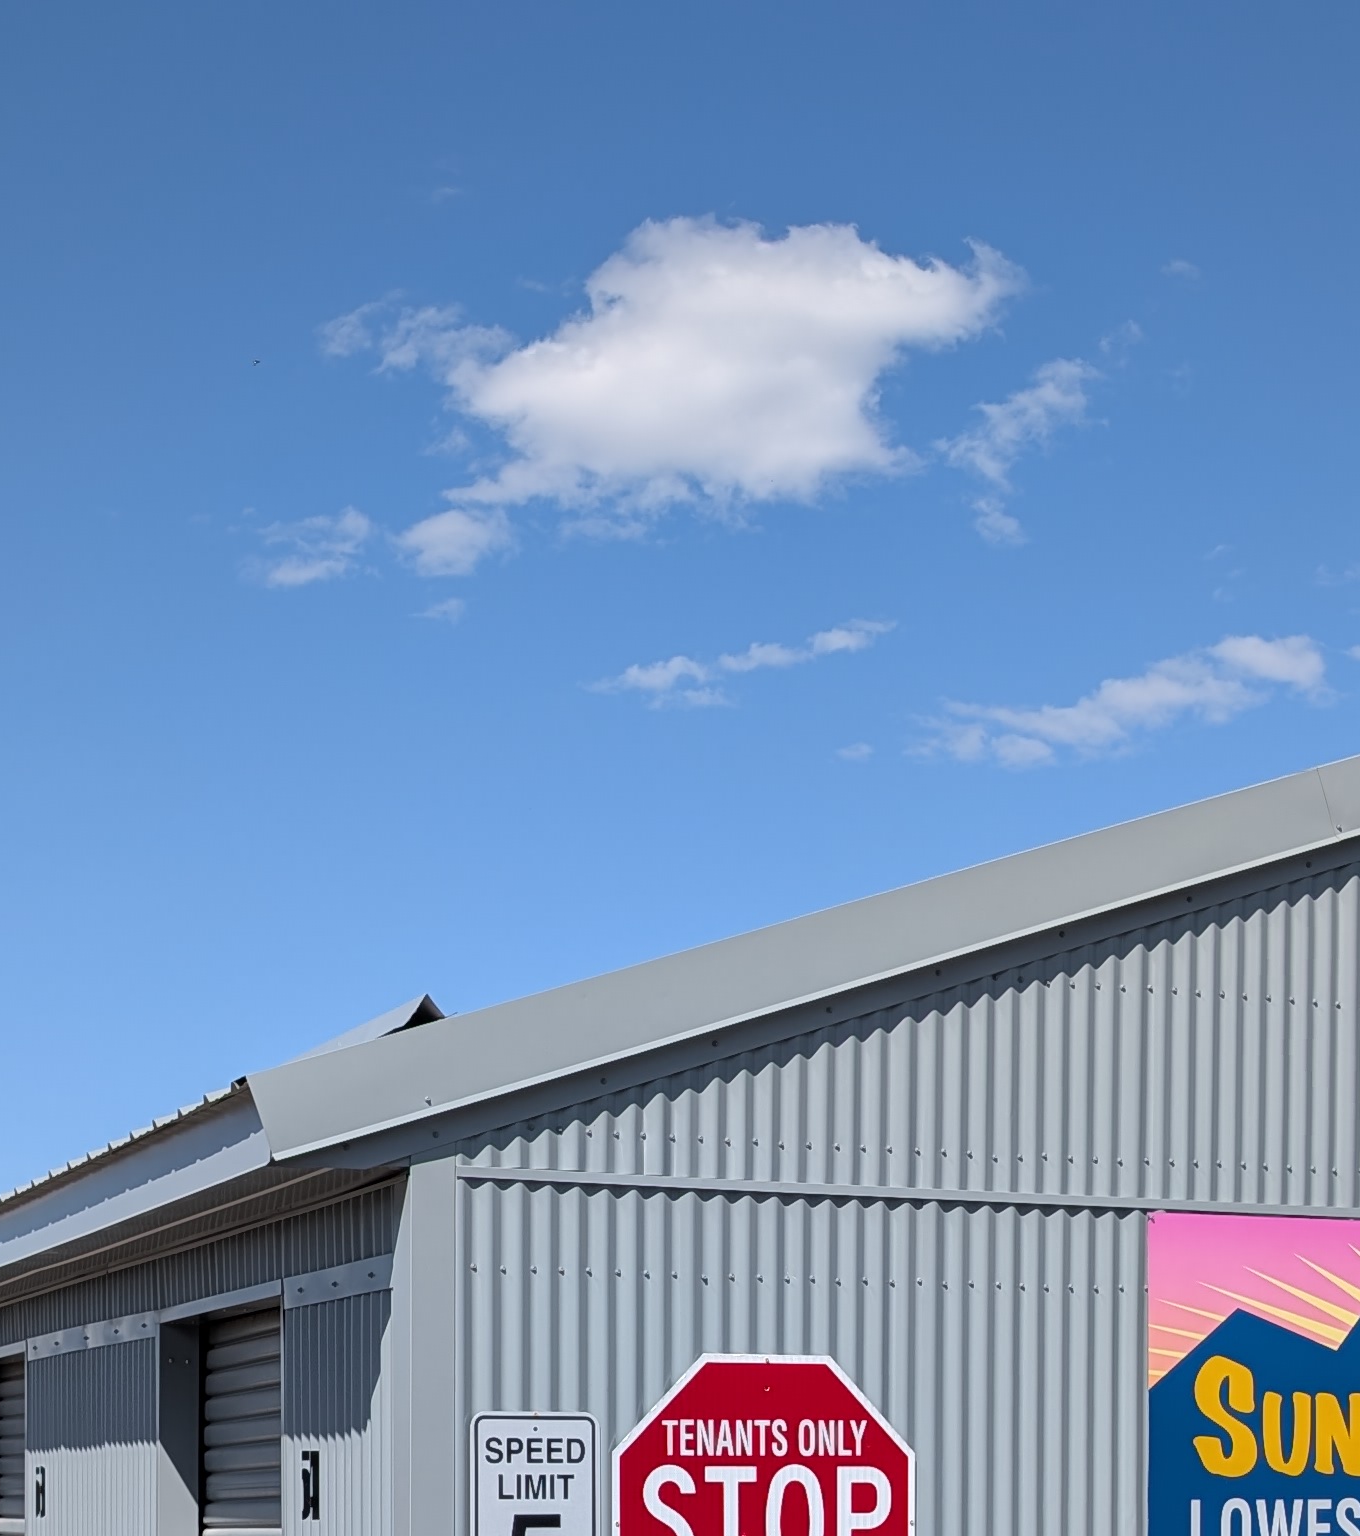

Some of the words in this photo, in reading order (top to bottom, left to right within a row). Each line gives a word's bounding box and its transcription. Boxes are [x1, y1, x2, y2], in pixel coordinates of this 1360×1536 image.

[484, 1436, 586, 1464] SPEED
[661, 1419, 788, 1457] TENANTS
[797, 1419, 868, 1456] ONLY
[497, 1473, 575, 1501] LIMIT
